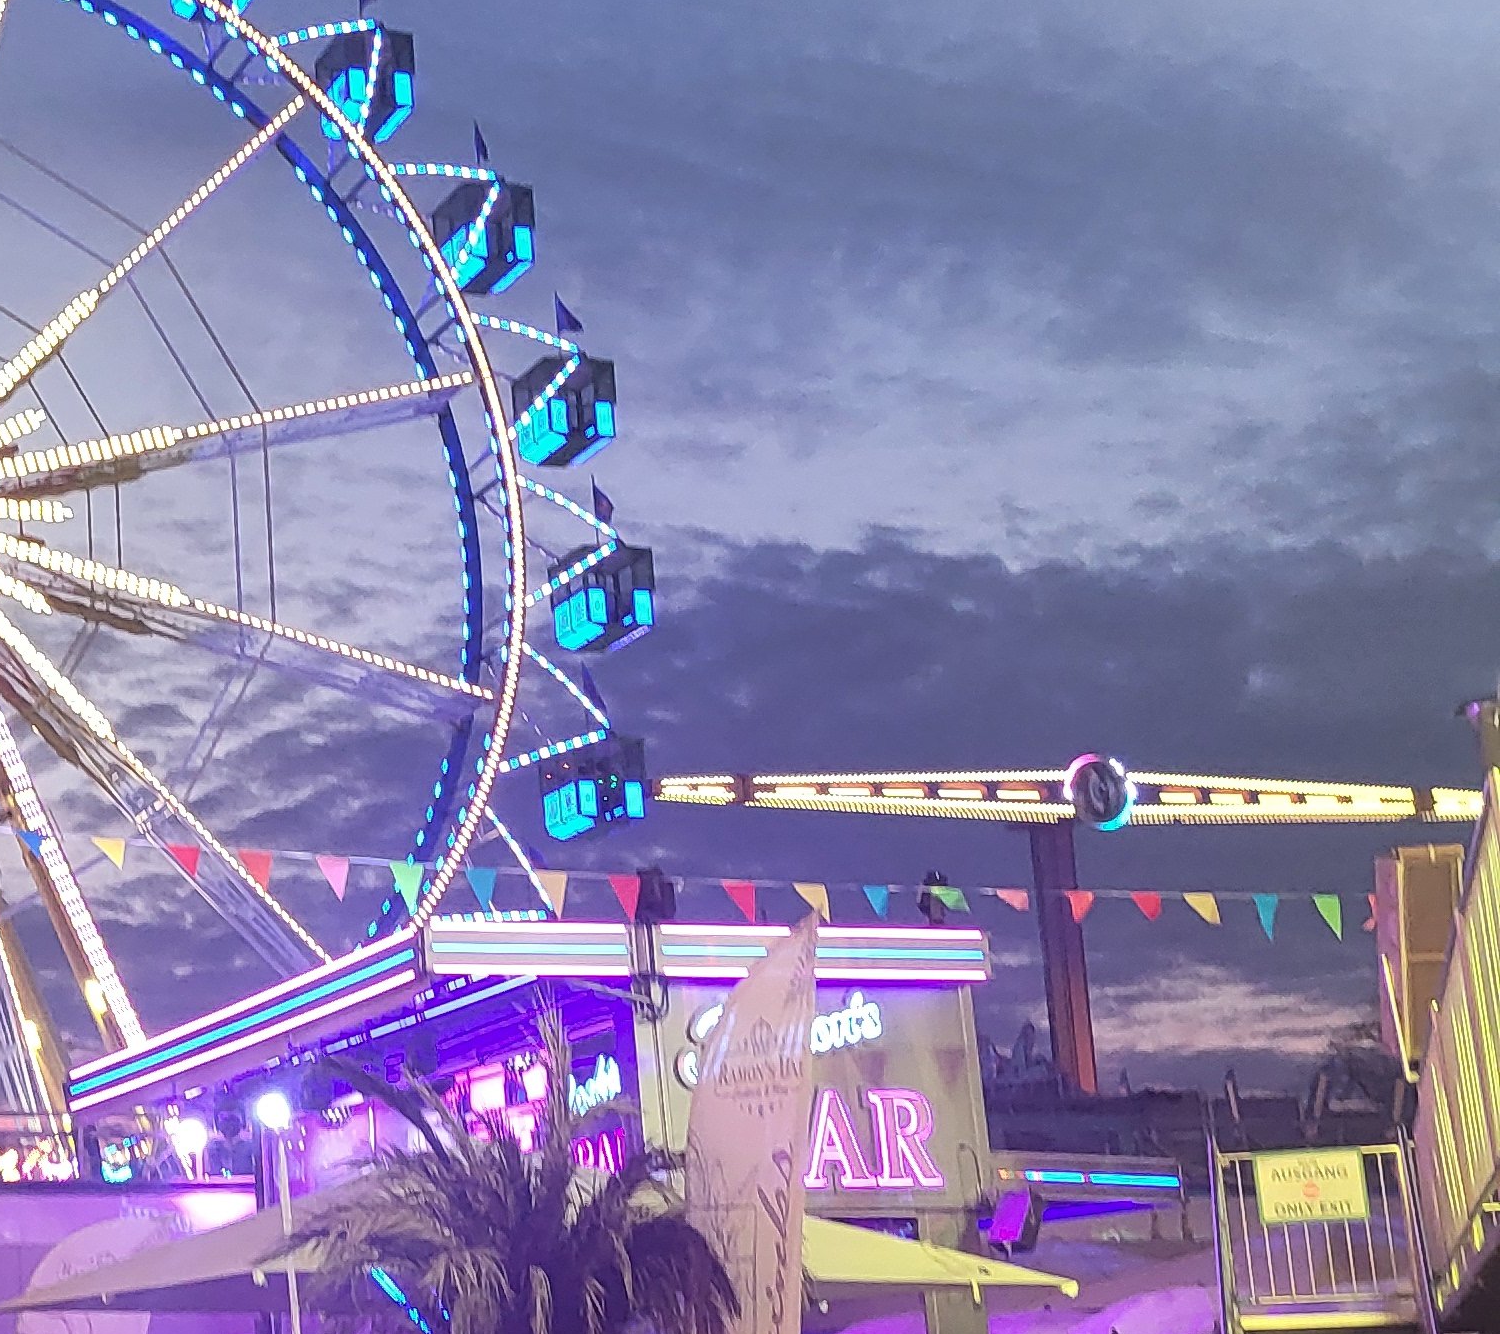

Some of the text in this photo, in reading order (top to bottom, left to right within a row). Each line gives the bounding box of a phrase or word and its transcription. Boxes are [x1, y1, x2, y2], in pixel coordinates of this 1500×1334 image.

[802, 1088, 945, 1189] AR
[1270, 1164, 1349, 1183] AUSGANG
[1274, 1198, 1352, 1219] ONLY EXIT
